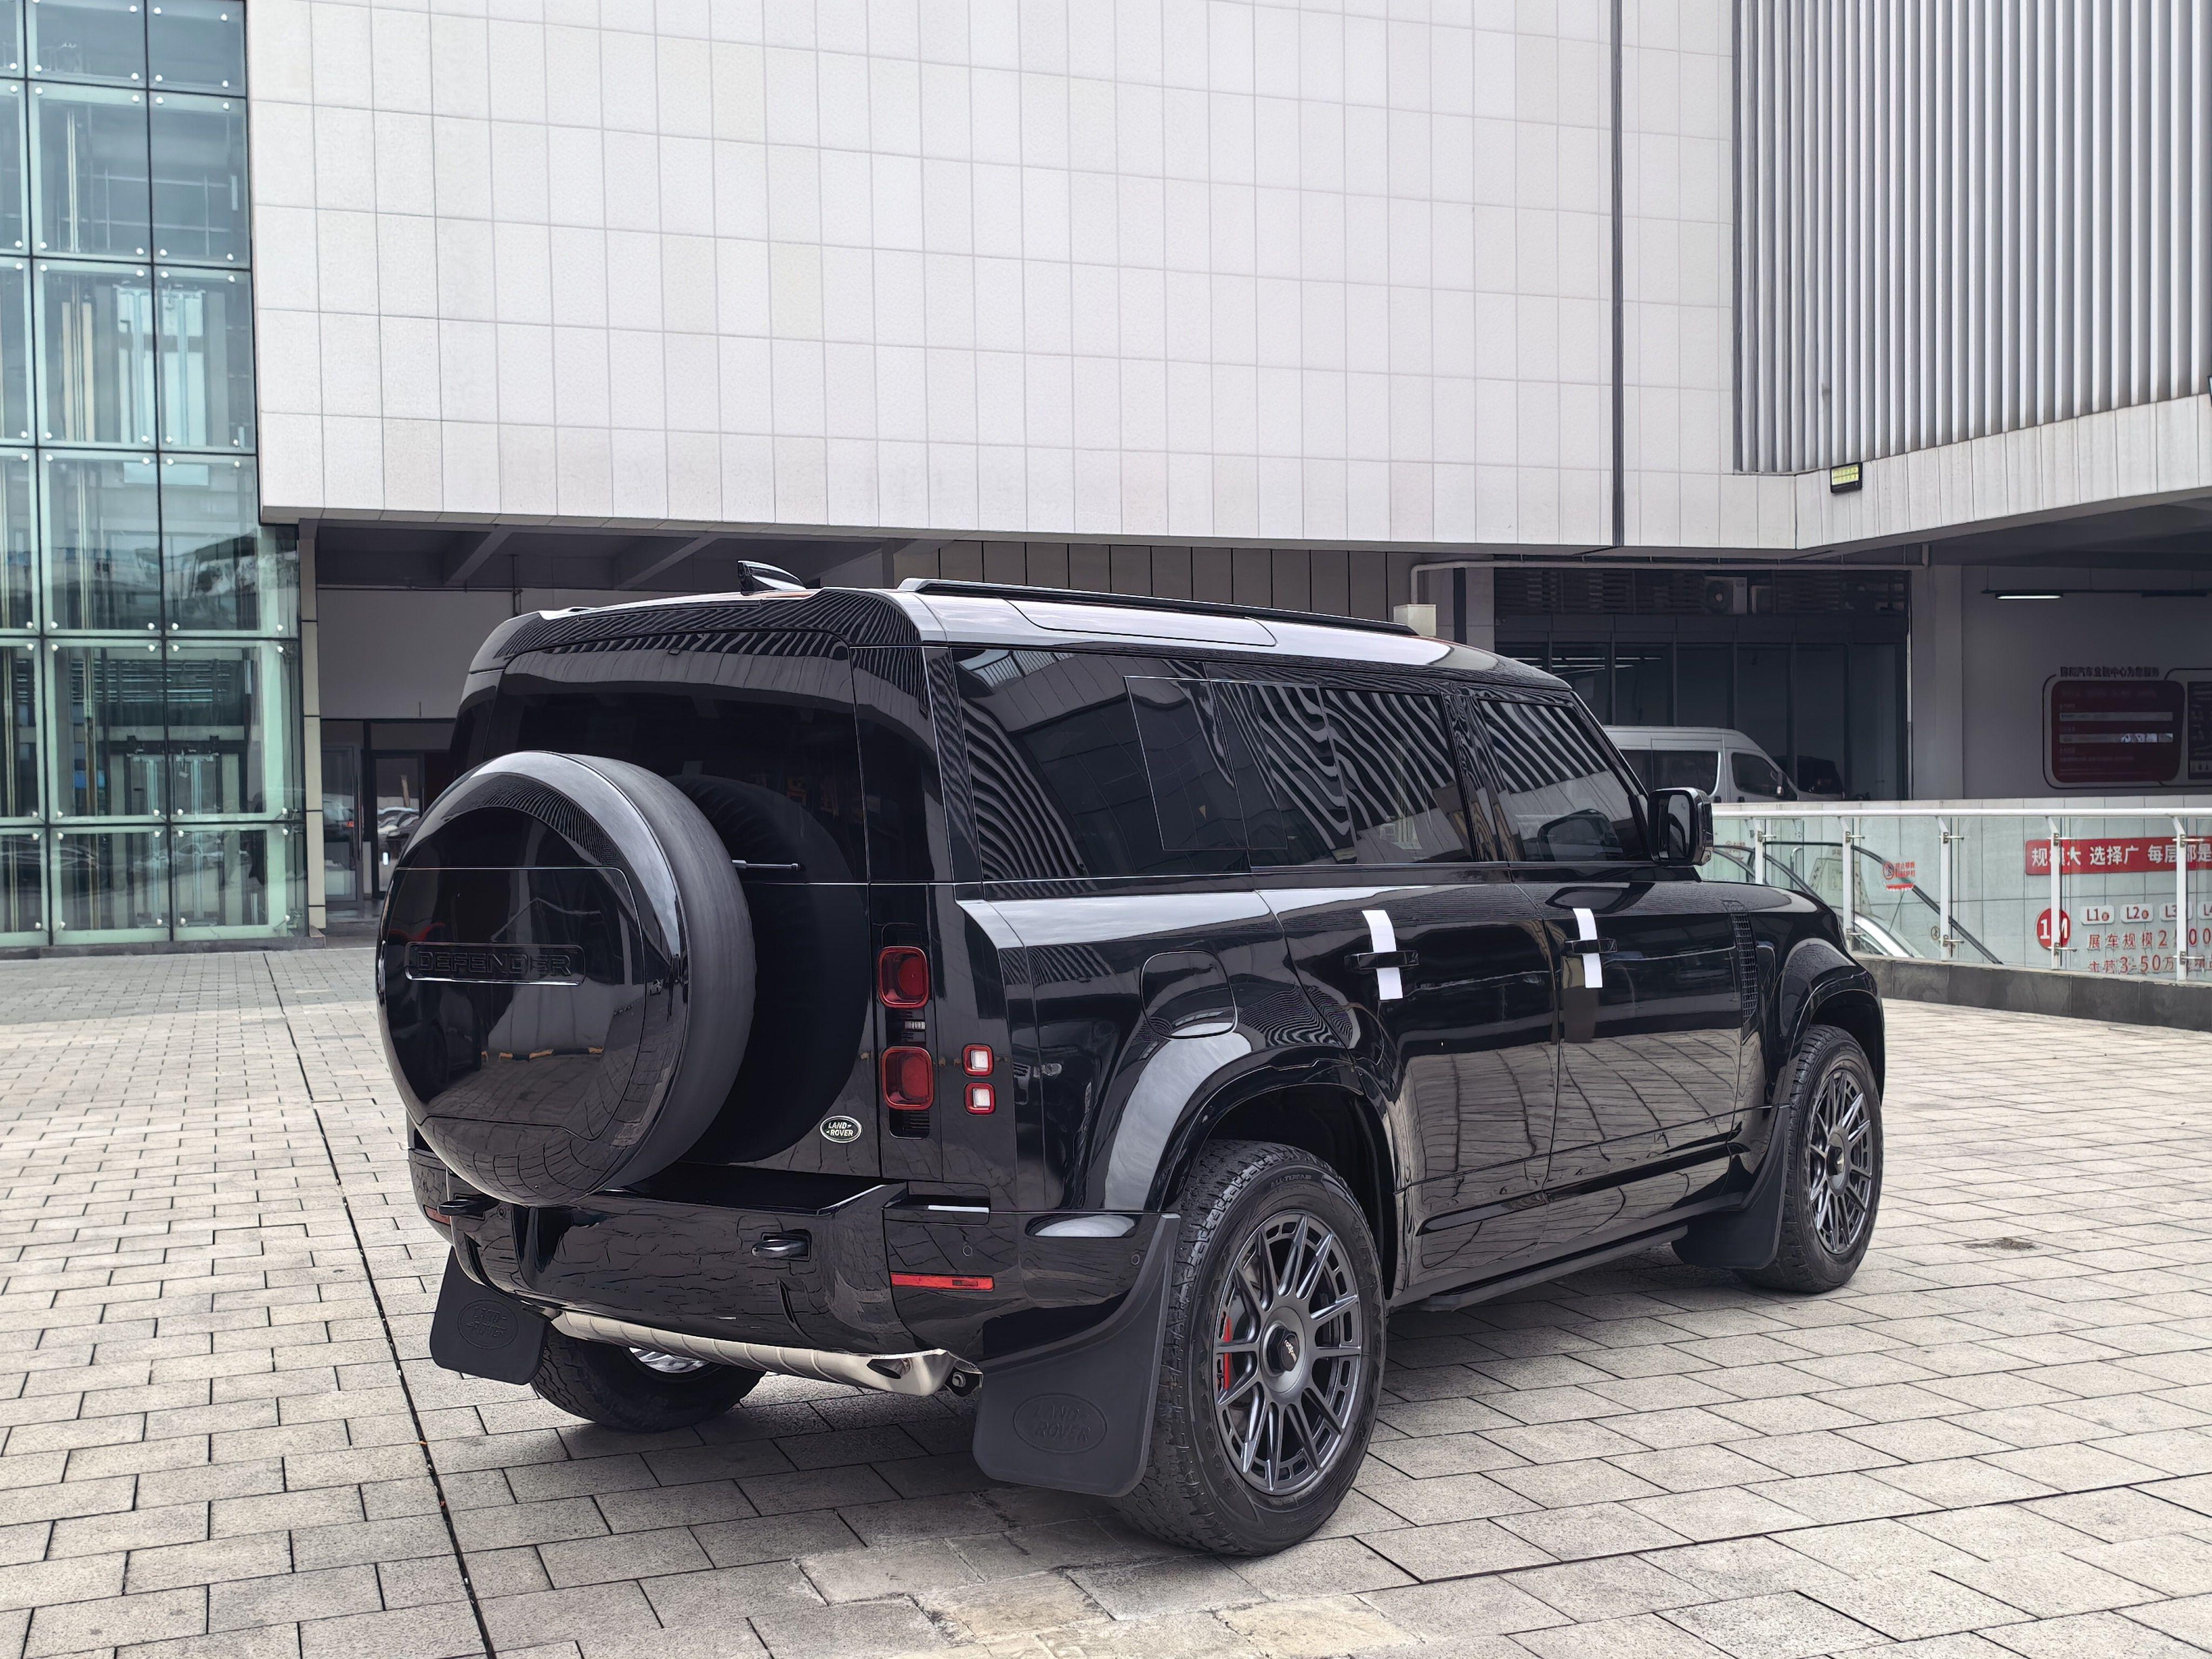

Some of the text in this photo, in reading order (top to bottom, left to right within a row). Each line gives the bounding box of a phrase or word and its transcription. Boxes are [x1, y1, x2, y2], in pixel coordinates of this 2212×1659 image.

[2090, 845, 2139, 865] 选择广
[2088, 928, 2211, 949] 展车规模200
[417, 951, 572, 976] DEFENDER
